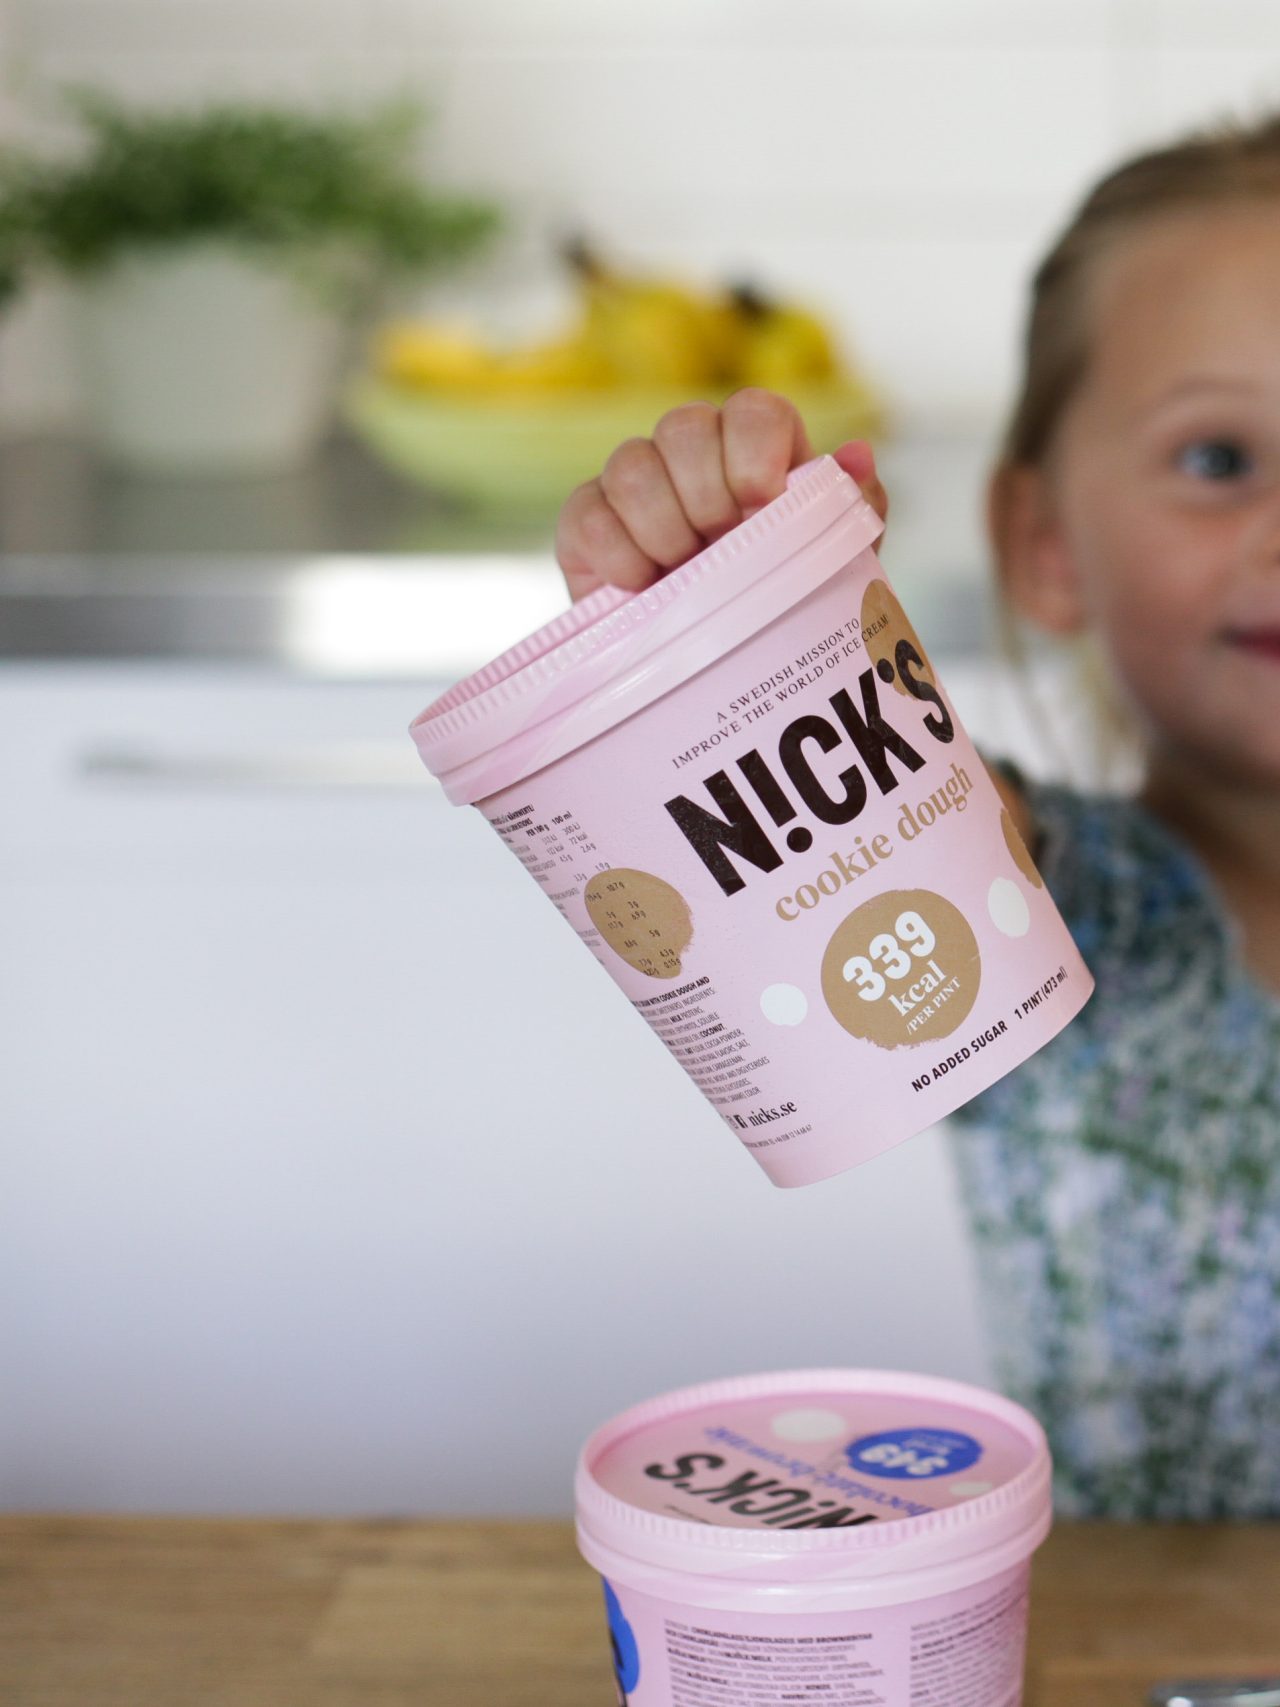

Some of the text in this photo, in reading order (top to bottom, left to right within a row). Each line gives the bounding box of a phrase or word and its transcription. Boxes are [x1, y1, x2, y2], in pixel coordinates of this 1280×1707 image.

[671, 615, 889, 769] IMPROVE THE WORLD OF ICE CREAM
[716, 617, 860, 724] A SWEDISH MISSION TO
[552, 815, 564, 825] 100
[775, 763, 974, 922] cookie dough
[676, 982, 697, 996] DOUGH
[695, 976, 710, 988] AND
[842, 911, 936, 1001] 339
[888, 959, 947, 1017] kcal
[933, 976, 961, 1009] PINT
[911, 1074, 931, 1093] NO
[931, 1047, 971, 1080] ADDED
[970, 1020, 1009, 1053] SUGAR
[1013, 1008, 1023, 1020] 1
[1021, 994, 1043, 1015] PINT
[747, 1101, 798, 1127] nicks.se
